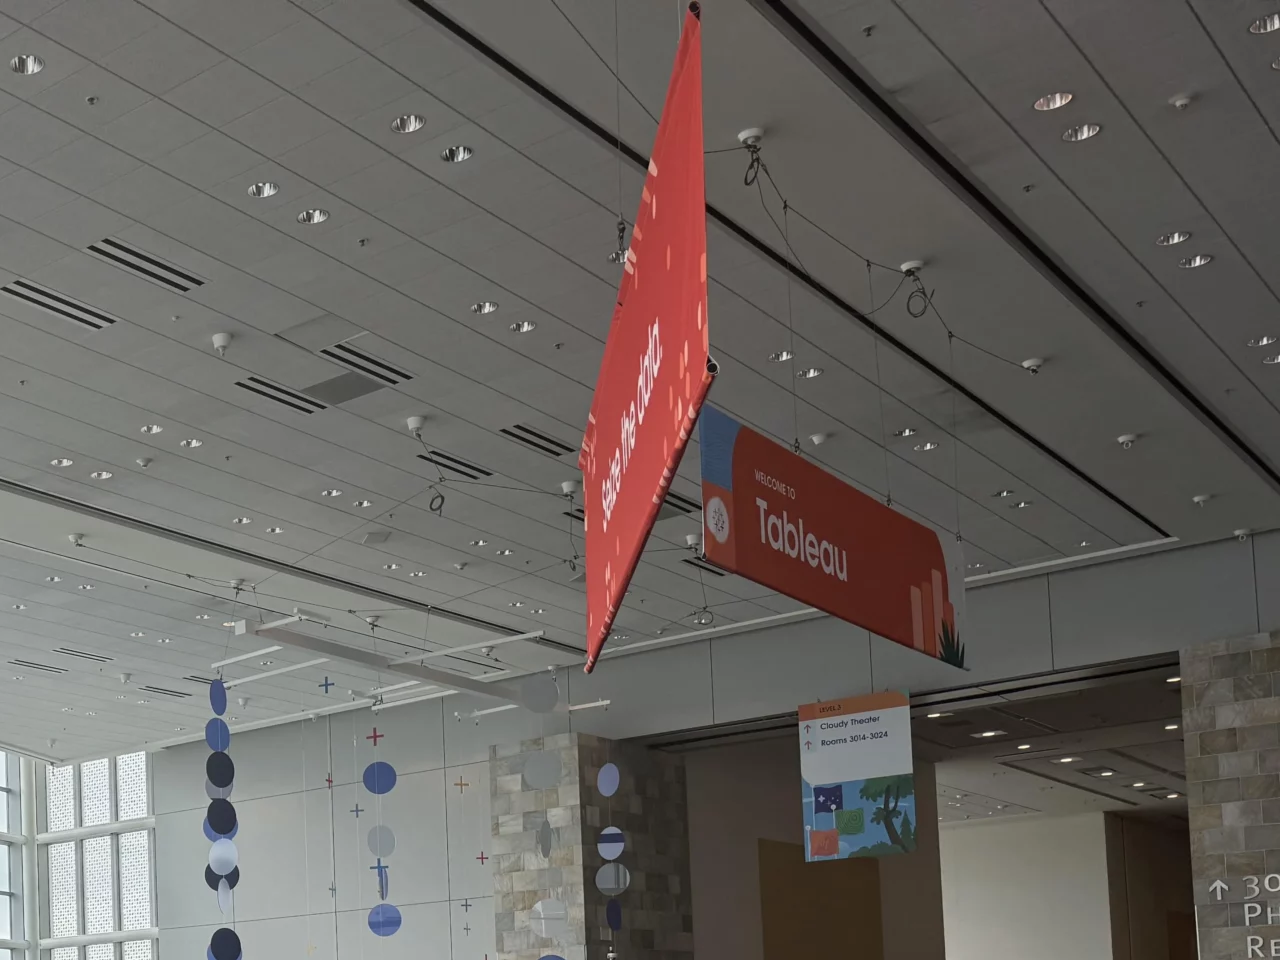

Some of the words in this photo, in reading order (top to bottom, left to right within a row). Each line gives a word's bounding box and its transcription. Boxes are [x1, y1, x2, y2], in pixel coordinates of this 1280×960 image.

[602, 447, 621, 533] Seize
[621, 400, 636, 475] the
[637, 316, 663, 426] data.
[754, 469, 786, 495] WELCOME
[787, 485, 796, 500] TO
[755, 497, 847, 582] Tableau
[819, 706, 837, 714] LEVEL
[820, 720, 849, 730] Cloudy
[850, 716, 881, 726] Theater
[821, 737, 848, 747] Rooms
[849, 731, 889, 743] 3014-3024
